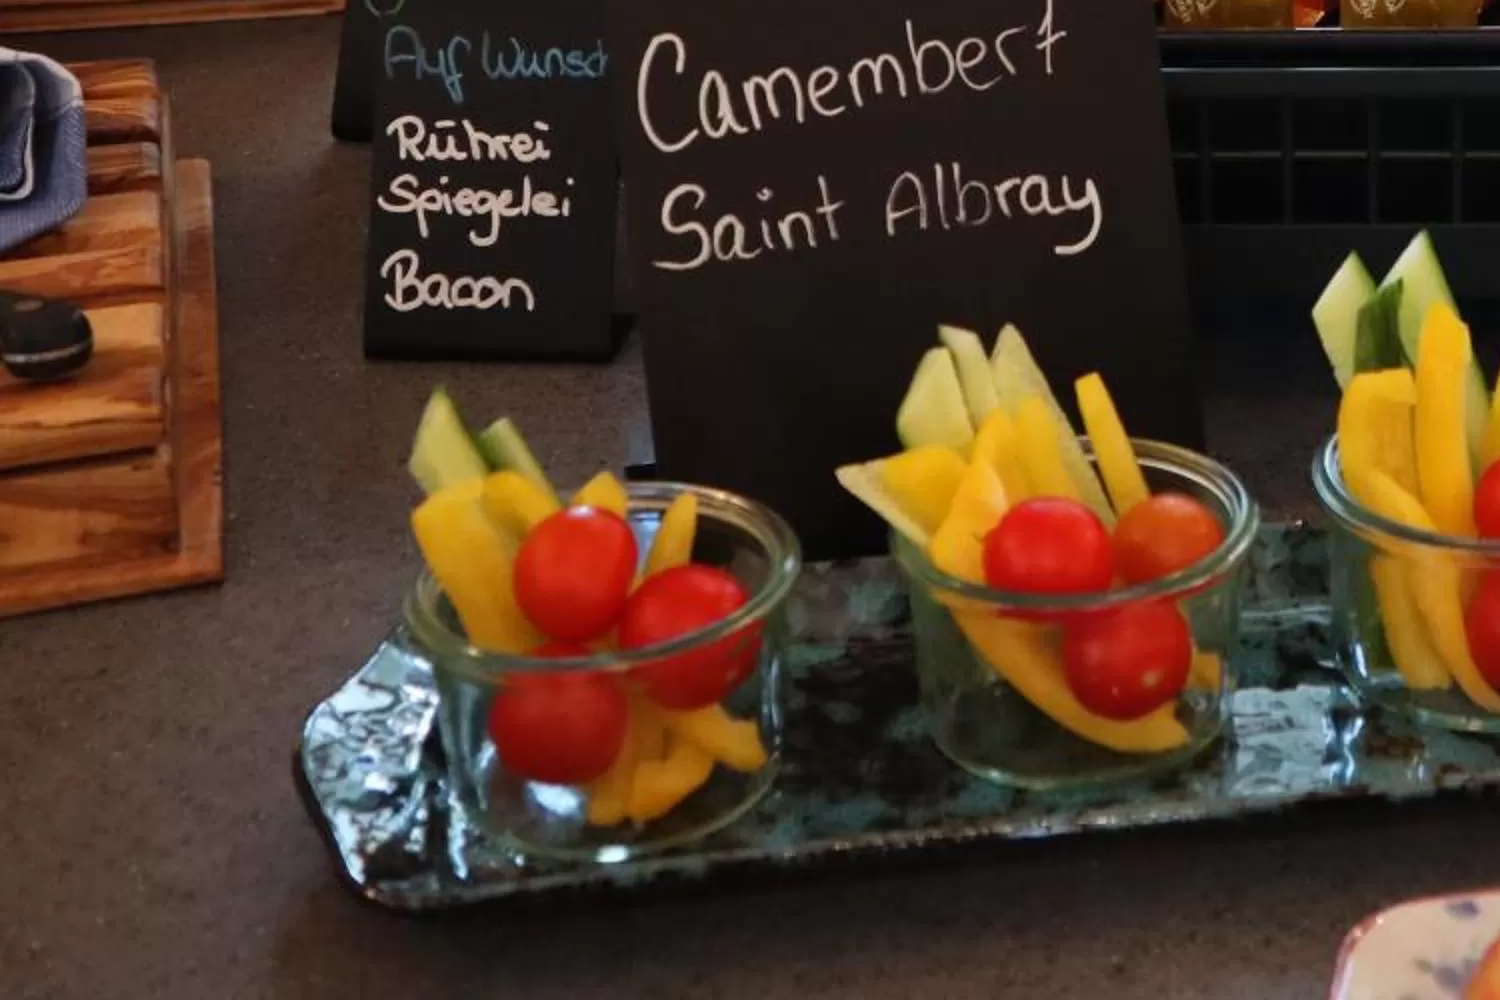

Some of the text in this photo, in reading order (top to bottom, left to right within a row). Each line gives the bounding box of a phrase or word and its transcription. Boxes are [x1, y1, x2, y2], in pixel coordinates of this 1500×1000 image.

[385, 25, 471, 103] Auf
[377, 174, 574, 246] Spiegelei
[653, 162, 1102, 270] Saint Albray
[381, 249, 534, 311] Bacon
